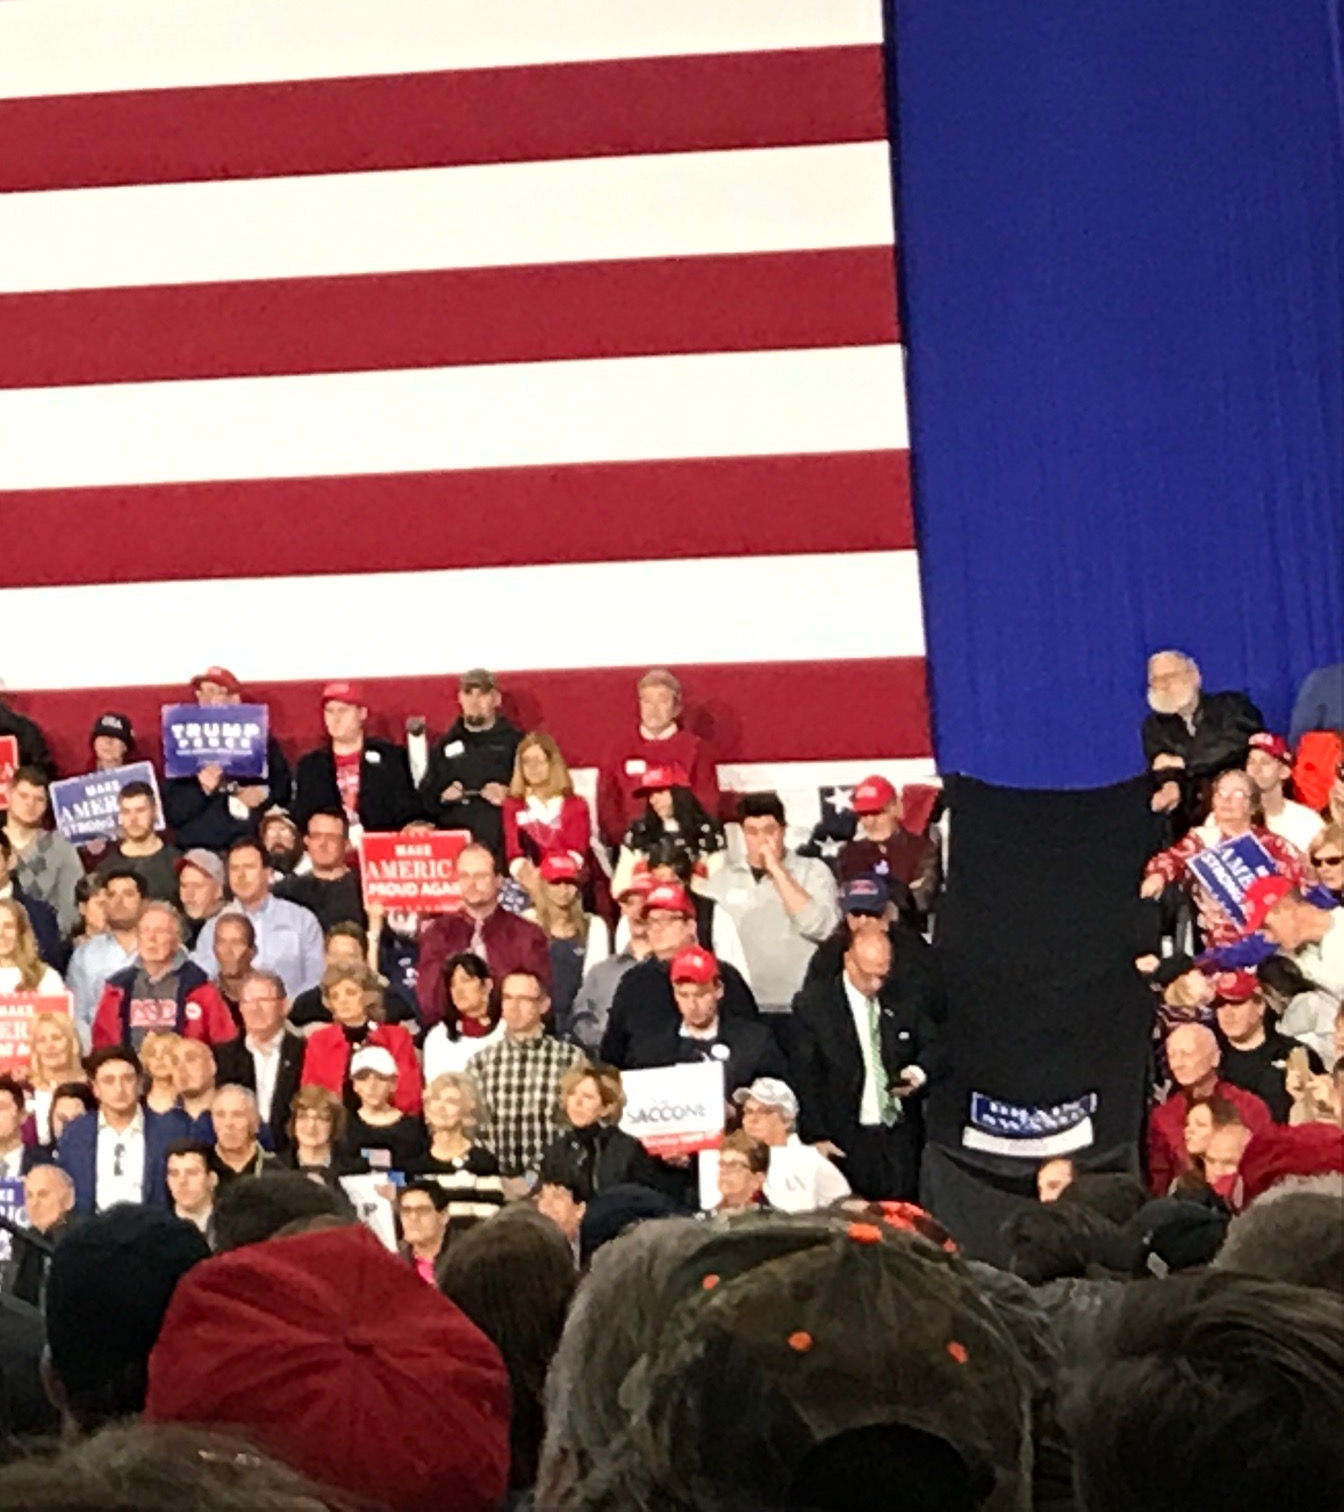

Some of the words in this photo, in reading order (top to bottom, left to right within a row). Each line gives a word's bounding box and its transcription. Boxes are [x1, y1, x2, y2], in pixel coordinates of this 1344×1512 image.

[171, 722, 260, 739] TRUMP
[85, 780, 120, 796] MAKE
[61, 795, 120, 822] AMER
[395, 844, 431, 857] MAKE
[367, 859, 453, 880] AMERIC
[368, 882, 418, 897] PROUD
[626, 1105, 706, 1125] SACCONE
